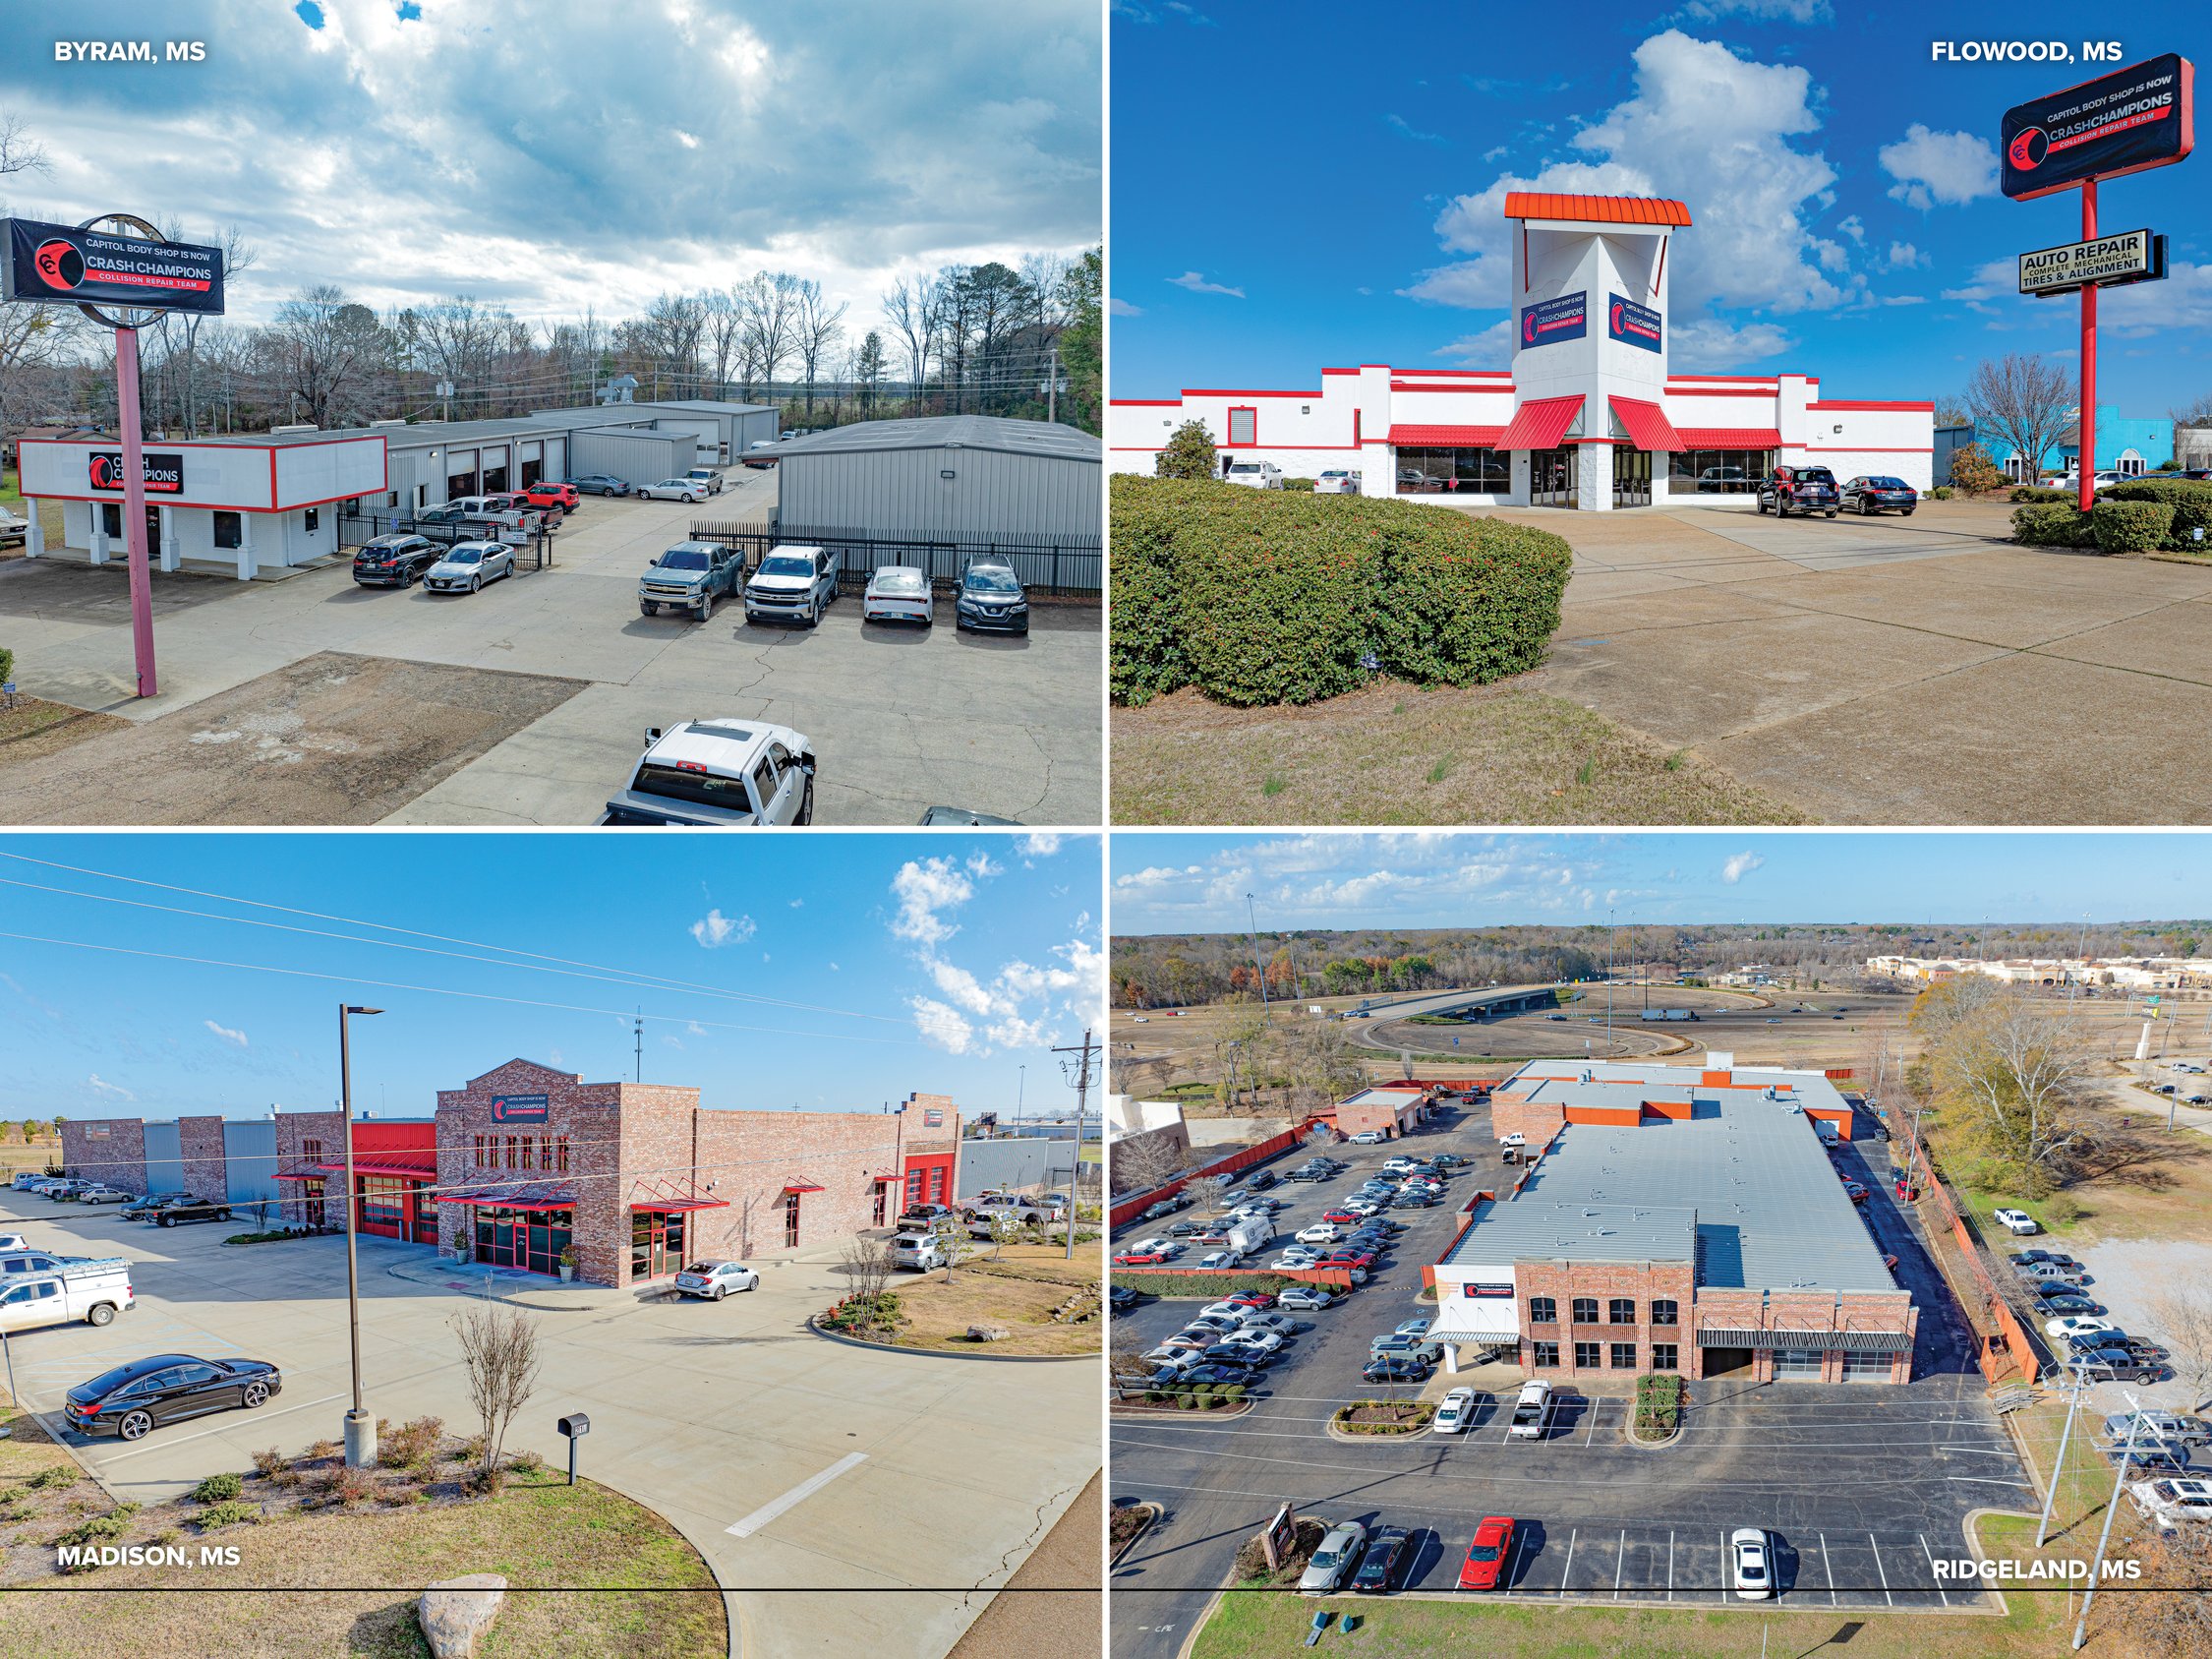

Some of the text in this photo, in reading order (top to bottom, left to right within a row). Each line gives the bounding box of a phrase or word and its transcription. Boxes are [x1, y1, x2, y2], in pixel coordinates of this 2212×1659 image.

[2048, 75, 2172, 123] CAPITOL BODY SHOP IS NOW
[2059, 112, 2154, 148] COLLISION REPAIR TEAM
[86, 238, 125, 252] CAPITOL
[128, 246, 152, 255] BODY
[154, 249, 178, 257] SHOP
[190, 253, 210, 261] NOW
[2025, 237, 2138, 270] AUTO REPAIR
[2024, 259, 2139, 286] TIRES & ALIGNMENT
[2029, 252, 2132, 276] COMPLETE MECHANICAL
[99, 273, 143, 283] COLLISION
[114, 469, 178, 481] CPIONS
